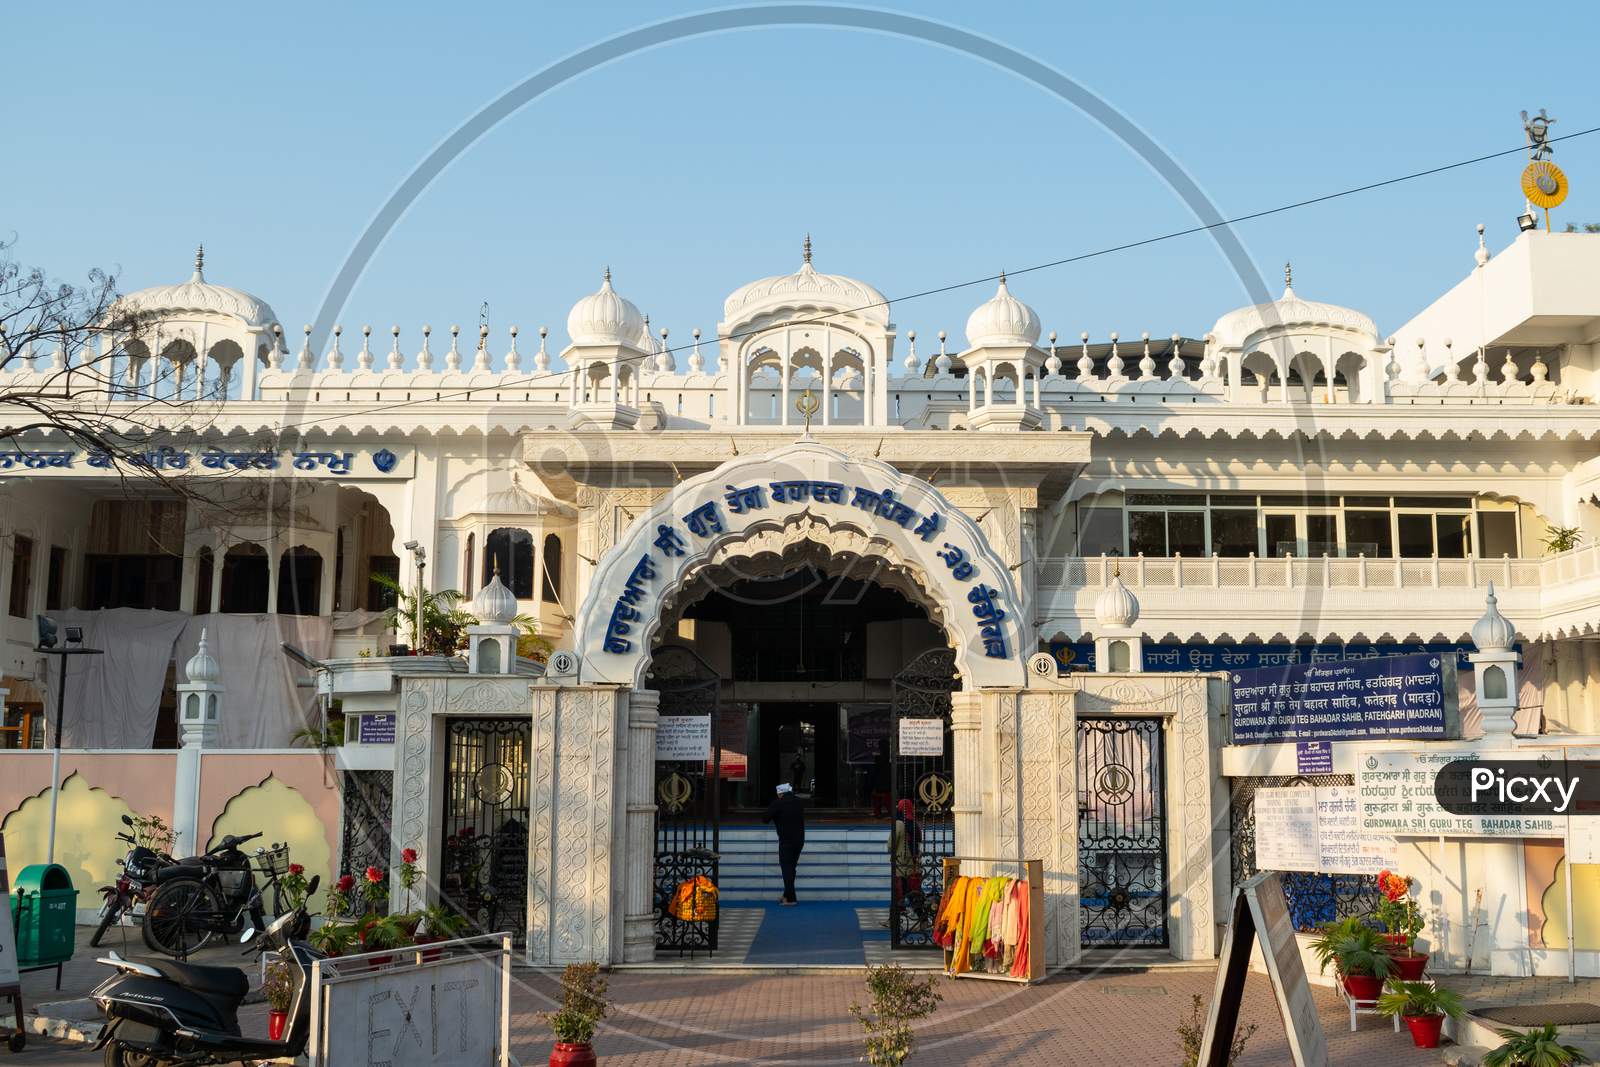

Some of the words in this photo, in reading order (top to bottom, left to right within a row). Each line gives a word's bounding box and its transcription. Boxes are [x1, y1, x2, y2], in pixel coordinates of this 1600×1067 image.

[293, 452, 355, 475] ਨਾਮੁ
[603, 553, 656, 655] ਗੁਰਦੁਆਰਾ
[724, 485, 762, 513] ਤੇਗ
[769, 480, 845, 503] ਬਹਾਦਰ
[851, 486, 916, 528] ਸਾਹਿਬ
[1147, 649, 1180, 664] ਜਾਈ
[1220, 648, 1250, 665] ਵੇਲਾ
[1234, 687, 1267, 699] ਗੁਰਦੁਆਰਾ
[1310, 682, 1335, 692] ਬਹਾਦਰ
[1261, 698, 1270, 711] श्री
[1304, 699, 1328, 711] बहादर
[1234, 717, 1266, 727] GURDWARA
[1267, 716, 1277, 725] SRI
[1278, 716, 1295, 725] GURU
[1296, 715, 1308, 724] TEG
[1310, 714, 1340, 724] BAHADAR
[1341, 712, 1364, 722] SAHIB,
[1365, 709, 1405, 720] FATEHGARH
[1406, 708, 1442, 721] (MADRAN)
[1362, 771, 1400, 782] ਗੁਰਦੁਆਰਾ
[1364, 819, 1408, 828] GURDWARA
[1412, 819, 1426, 828] SRI
[1429, 819, 1452, 828] GURU
[1454, 819, 1472, 828] TEG
[1481, 819, 1521, 829] BAHADAR
[1525, 819, 1553, 830] SAHIB
[367, 978, 480, 1067] EXIT
